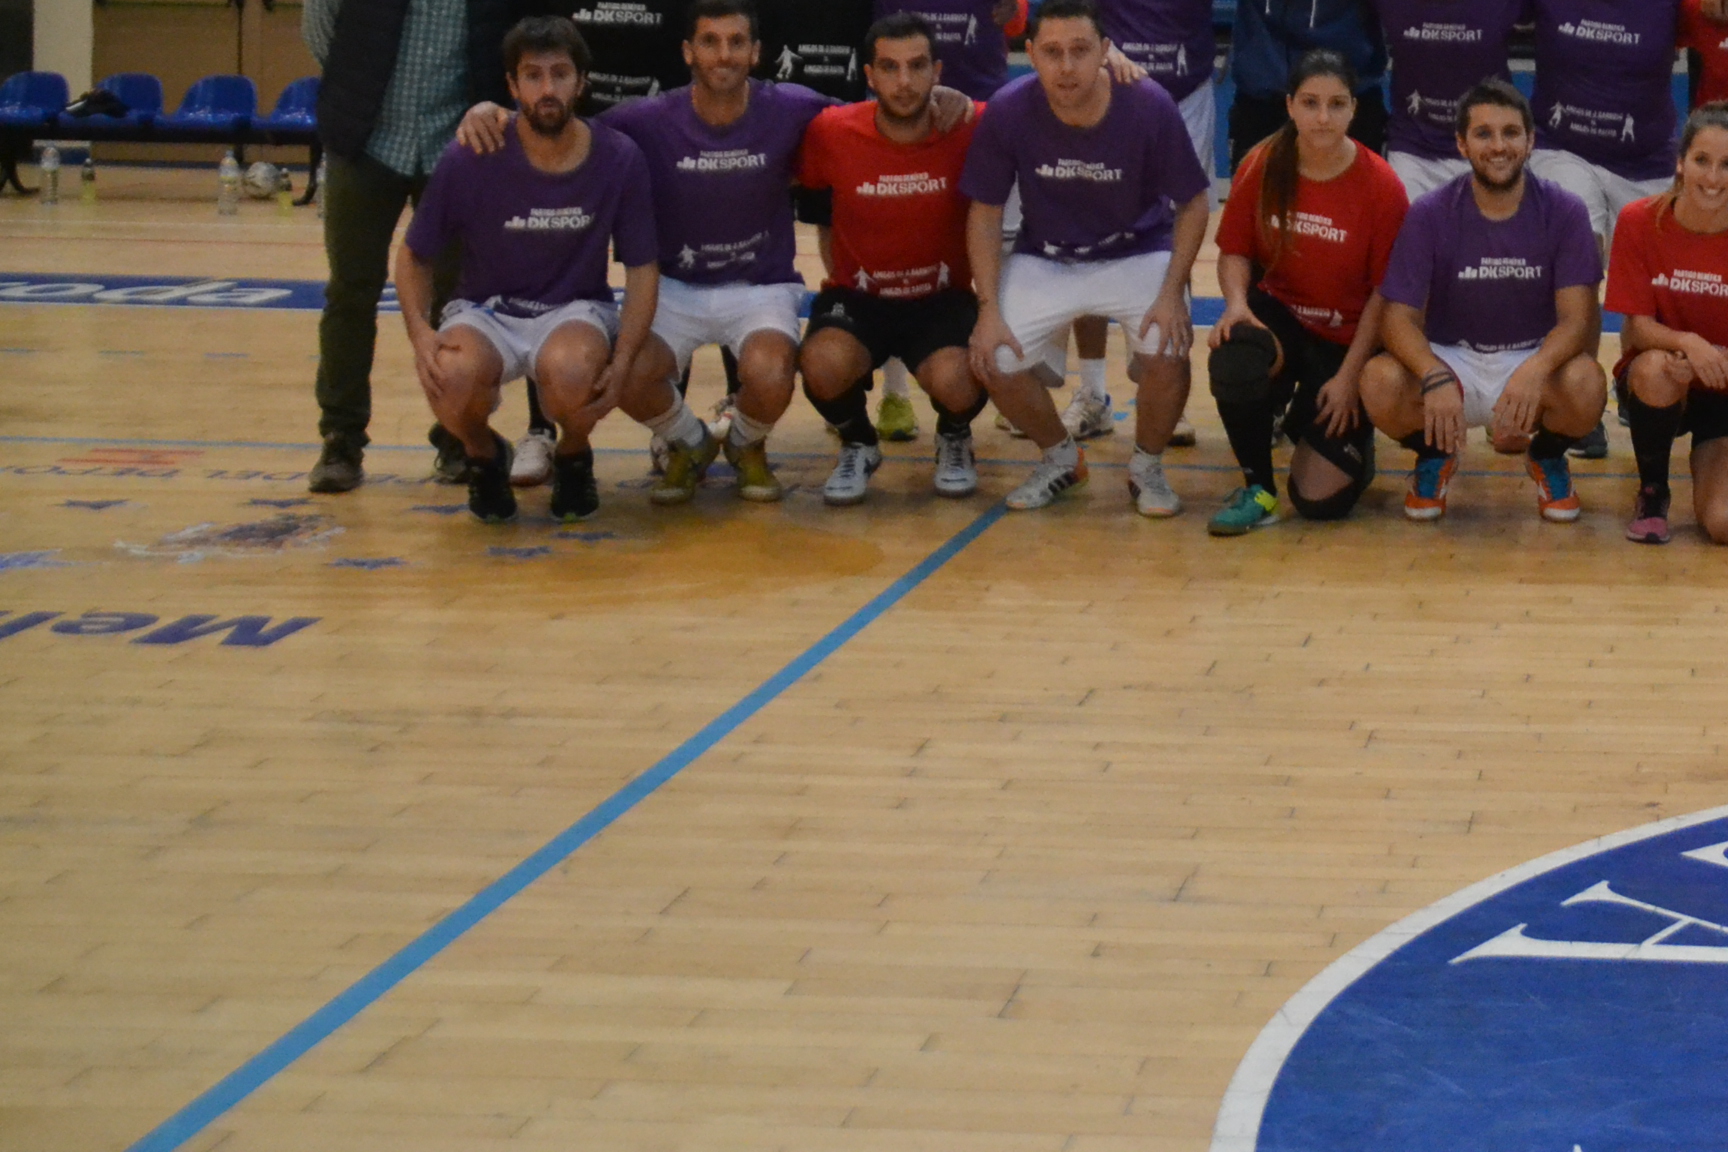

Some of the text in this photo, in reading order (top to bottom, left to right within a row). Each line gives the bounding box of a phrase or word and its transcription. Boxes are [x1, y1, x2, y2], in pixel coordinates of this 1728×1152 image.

[593, 9, 662, 24] DKSPORT
[1421, 29, 1482, 42] DKSPORT
[1576, 26, 1640, 44] DKSPORT
[698, 153, 767, 169] DKSPORT
[1055, 165, 1123, 181] DKSPORT
[877, 177, 948, 195] DKSPORT
[1479, 265, 1543, 279] DKSPORT
[0, 611, 323, 647] Mel
